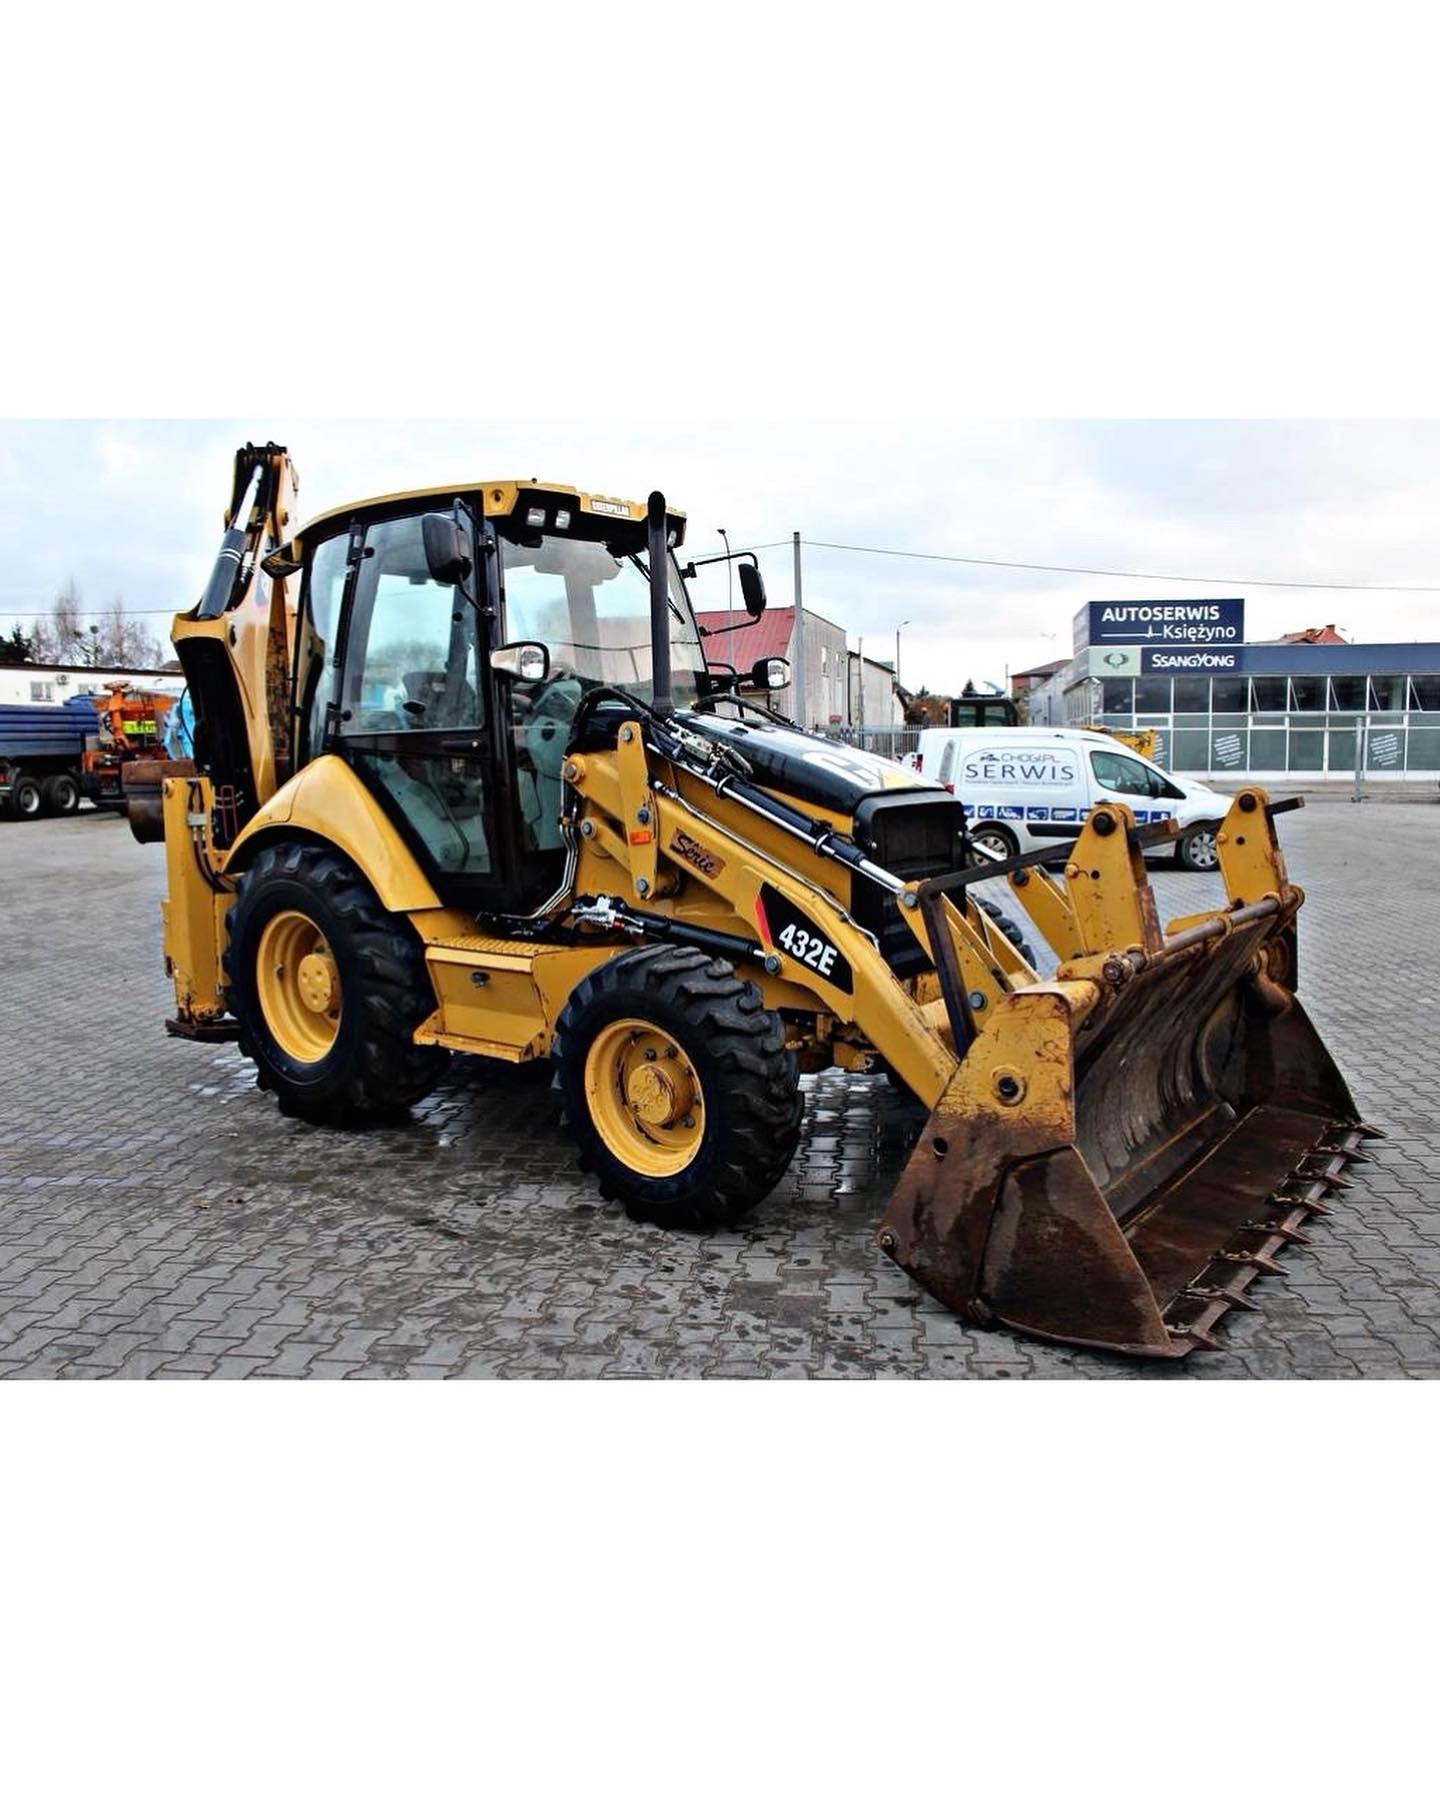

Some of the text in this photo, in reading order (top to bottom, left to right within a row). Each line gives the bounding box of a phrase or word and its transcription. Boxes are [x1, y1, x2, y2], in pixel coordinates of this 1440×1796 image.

[1101, 605, 1221, 622] AUTOSERWIS
[1162, 624, 1237, 642] Księżyno
[965, 763, 1075, 780] SERWIS
[778, 923, 838, 977] 432E
